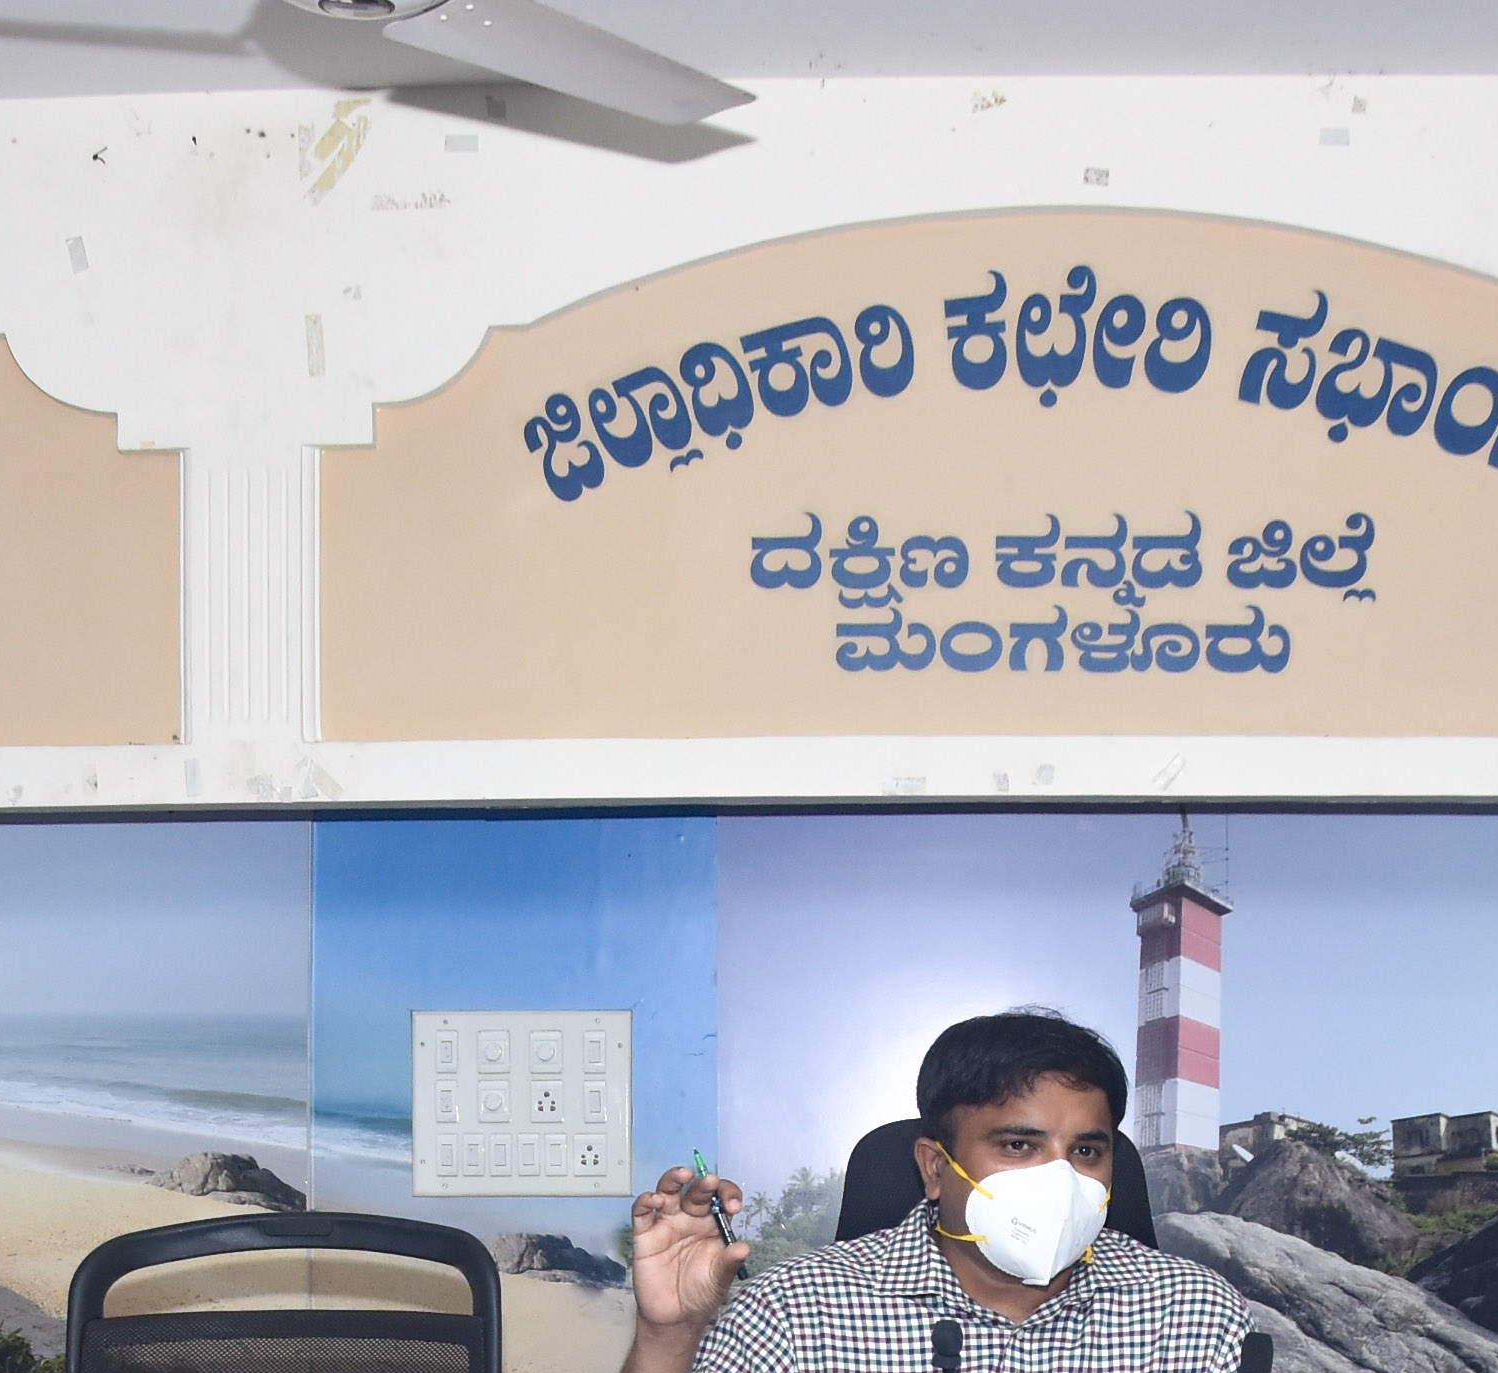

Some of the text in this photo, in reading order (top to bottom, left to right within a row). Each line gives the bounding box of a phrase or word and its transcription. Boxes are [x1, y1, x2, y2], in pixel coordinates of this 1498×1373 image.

[523, 303, 917, 502] ಜಿಲ್ಲಾಧಿಕಾರಿ
[943, 264, 1213, 409] ಕಛೇರಿ
[749, 511, 1377, 607] ದಕ್ಷಿಣ ಕನ್ನಡ ಜಿಲ್ಲೆ
[835, 604, 1293, 674] ಮಂಗಳೂರು
